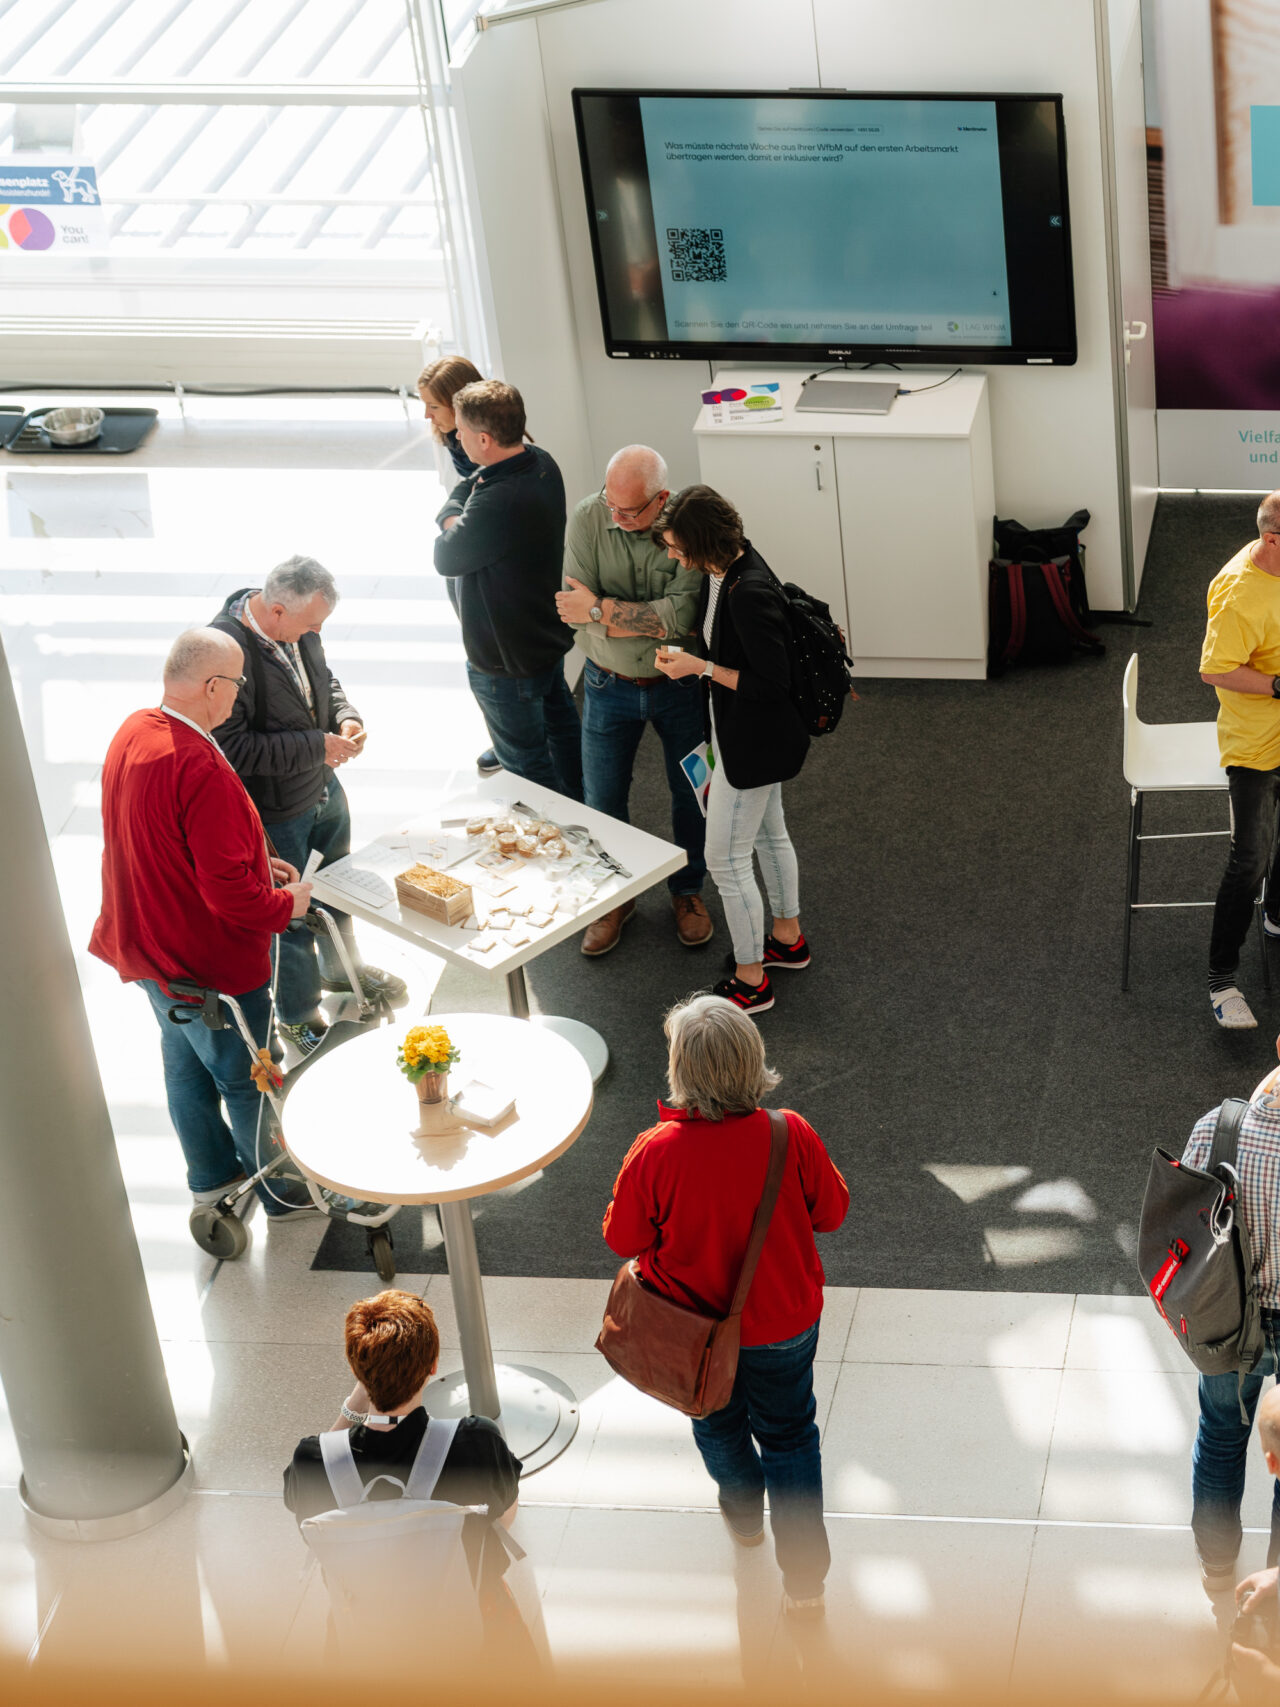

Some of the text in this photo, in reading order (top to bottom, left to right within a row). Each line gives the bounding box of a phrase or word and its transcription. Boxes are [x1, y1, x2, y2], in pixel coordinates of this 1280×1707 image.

[664, 142, 684, 150] Was
[684, 142, 714, 150] müsste
[716, 142, 748, 150] nächste
[750, 143, 780, 151] Woche
[797, 144, 816, 152] Ihrer
[844, 144, 858, 152] auf
[904, 145, 959, 153] Arbeitsmarkt
[666, 153, 712, 162] übertragen
[714, 154, 746, 162] werden,
[748, 154, 772, 162] damit
[783, 154, 820, 162] inklusiver
[822, 154, 844, 162] wird?
[60, 224, 84, 234] You
[62, 234, 88, 244] can!
[674, 320, 708, 328] Scannen
[710, 320, 723, 328] Sie
[724, 320, 740, 329] den
[742, 320, 779, 329] QR-Code
[780, 321, 792, 330] ein
[794, 322, 809, 330] und
[810, 322, 842, 330] nehmen
[845, 322, 857, 330] Sie
[871, 322, 884, 330] der
[886, 322, 918, 332] Umfrage
[1250, 451, 1278, 464] und
